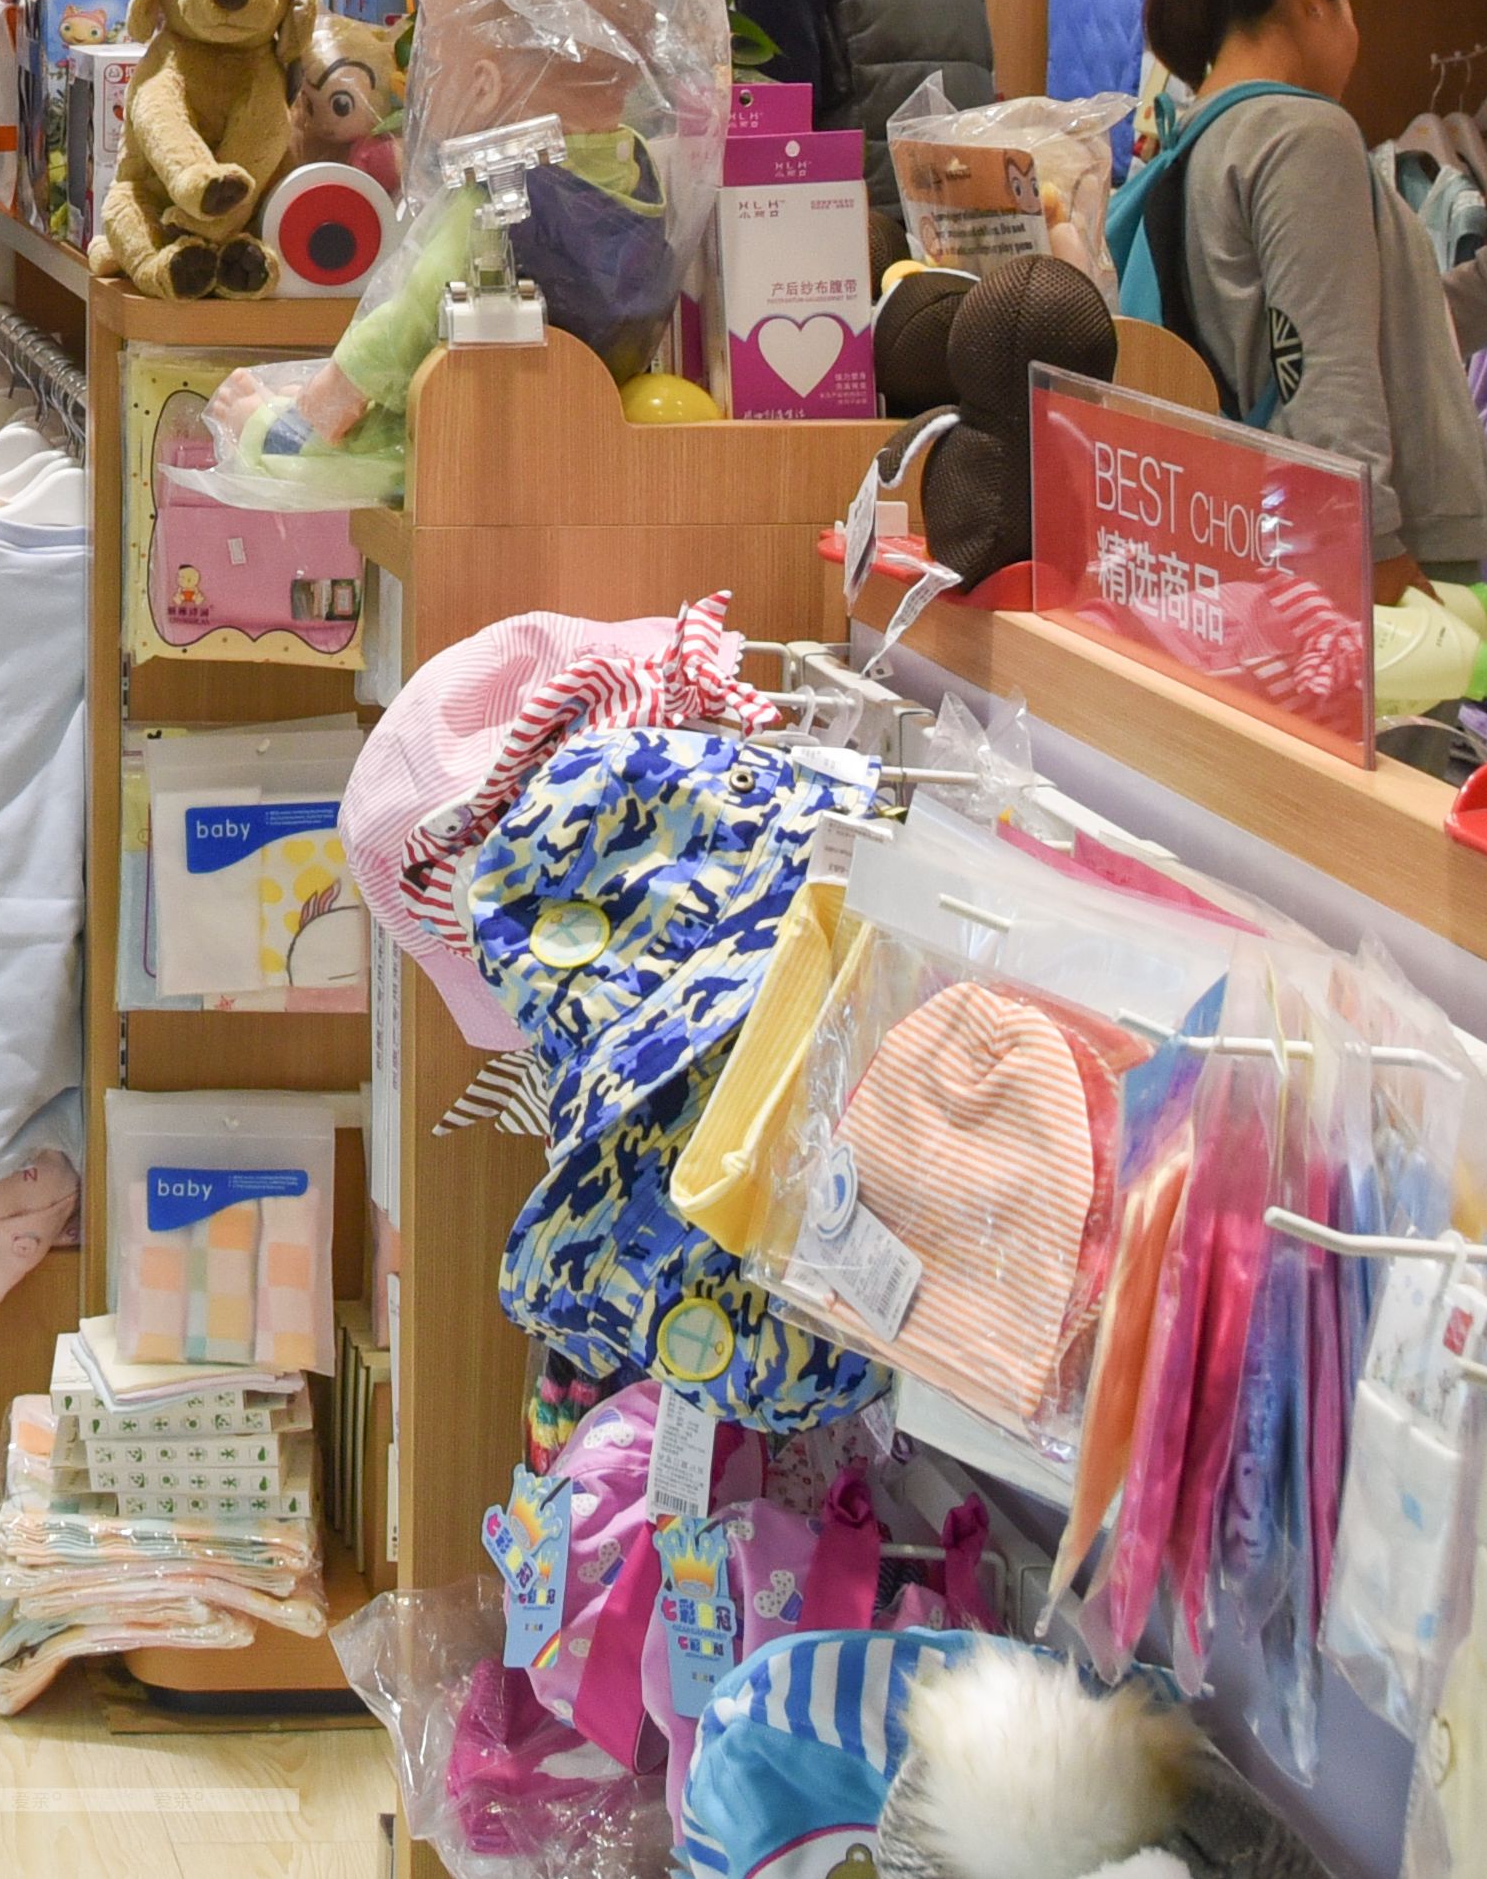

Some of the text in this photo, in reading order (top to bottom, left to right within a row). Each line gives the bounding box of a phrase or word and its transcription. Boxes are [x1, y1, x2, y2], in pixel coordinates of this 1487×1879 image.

[771, 280, 856, 296] 产后纱布腹带
[1093, 441, 1296, 578] BEST CHOICE
[1095, 525, 1225, 647] 精选商品
[195, 819, 251, 840] baby
[157, 1176, 214, 1201] baby
